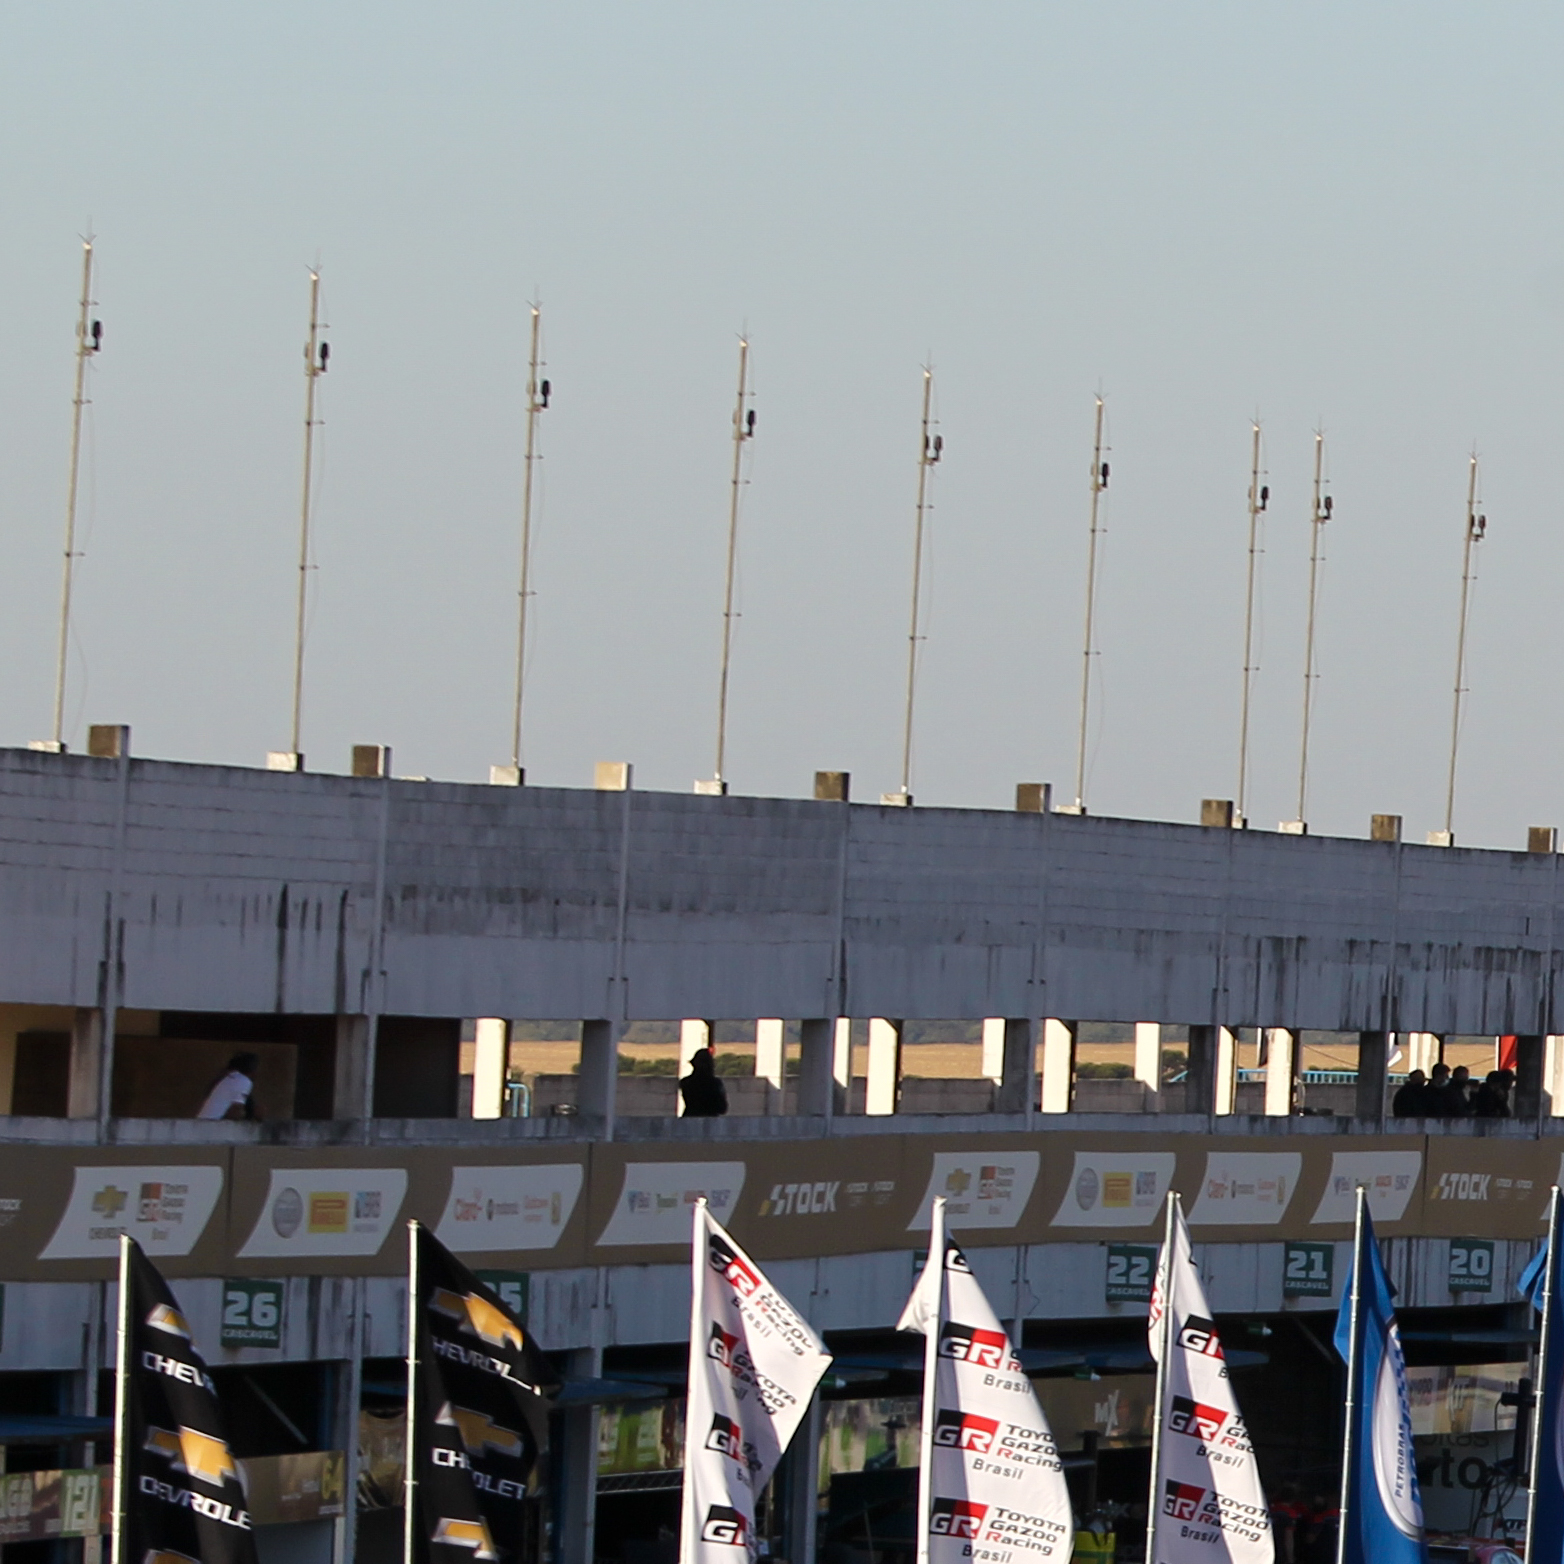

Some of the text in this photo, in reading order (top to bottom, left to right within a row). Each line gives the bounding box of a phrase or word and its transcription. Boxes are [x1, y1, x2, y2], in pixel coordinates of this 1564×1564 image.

[758, 1181, 841, 1217] STOCK
[1430, 1173, 1491, 1200] STOCK
[1109, 1255, 1150, 1285] 22
[1287, 1251, 1328, 1280] 21
[1450, 1248, 1491, 1277] 20
[225, 1291, 278, 1327] 26
[940, 1335, 1003, 1368] GR
[933, 1424, 994, 1453] GR
[1169, 1411, 1221, 1443] GR
[971, 1457, 1025, 1481] Brasil
[996, 1446, 1063, 1473] Racing
[1196, 1444, 1246, 1469] Brasil
[994, 1506, 1067, 1535] TOYOTA
[1163, 1494, 1198, 1520] GR
[1203, 1502, 1269, 1531] GAZOO
[929, 1511, 983, 1540] GR
[988, 1519, 1058, 1543] GAZOO
[1180, 1524, 1221, 1544] Brasil
[1197, 1513, 1263, 1543] Racing
[961, 1543, 1014, 1564] Brasil
[984, 1530, 1054, 1556] Racing
